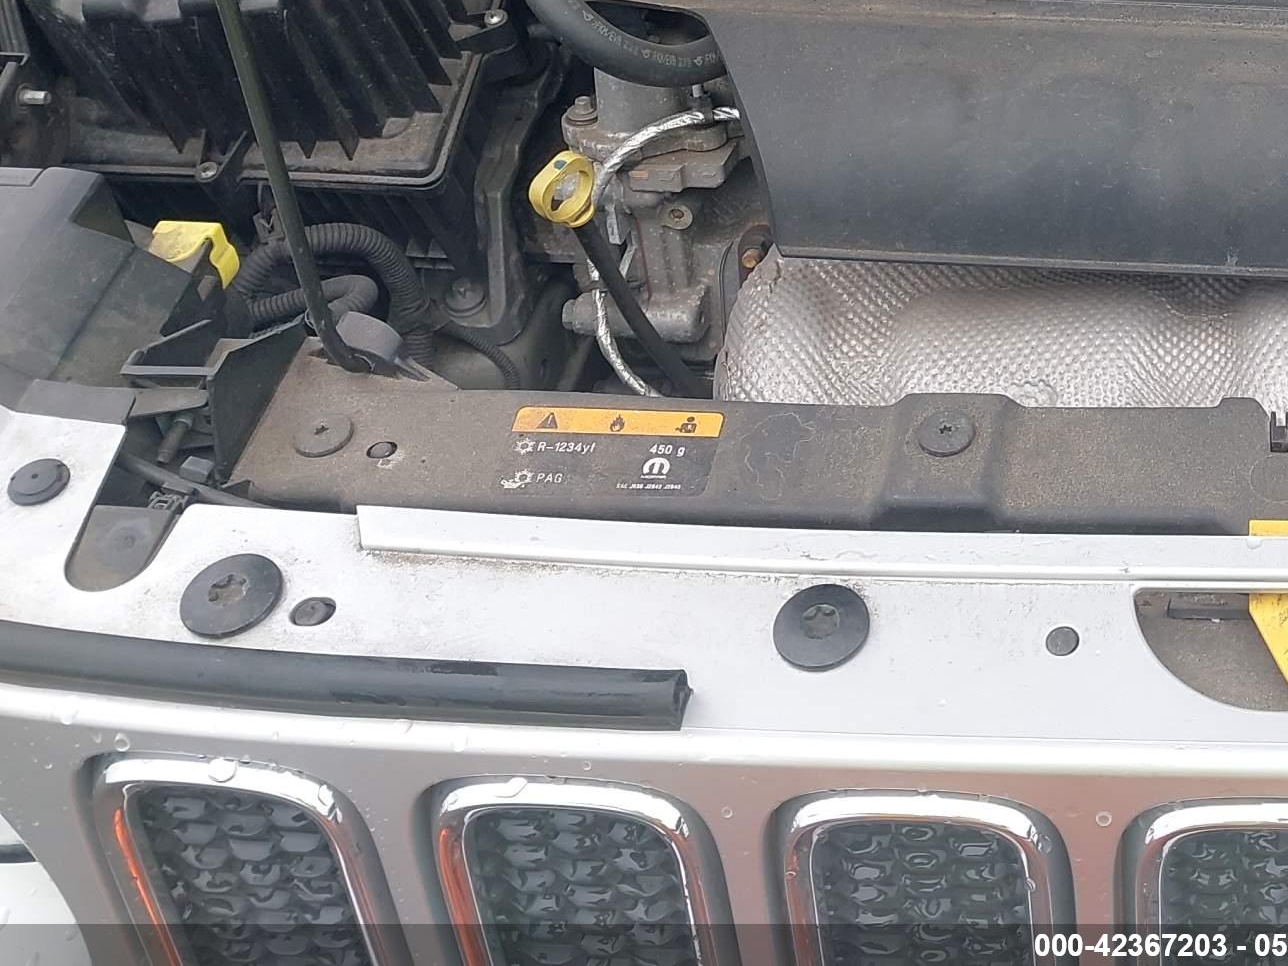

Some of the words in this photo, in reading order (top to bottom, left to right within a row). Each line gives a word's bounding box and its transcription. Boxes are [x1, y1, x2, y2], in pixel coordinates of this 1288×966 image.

[649, 443, 673, 455] 450
[676, 446, 686, 457] g
[535, 474, 563, 483] PAG
